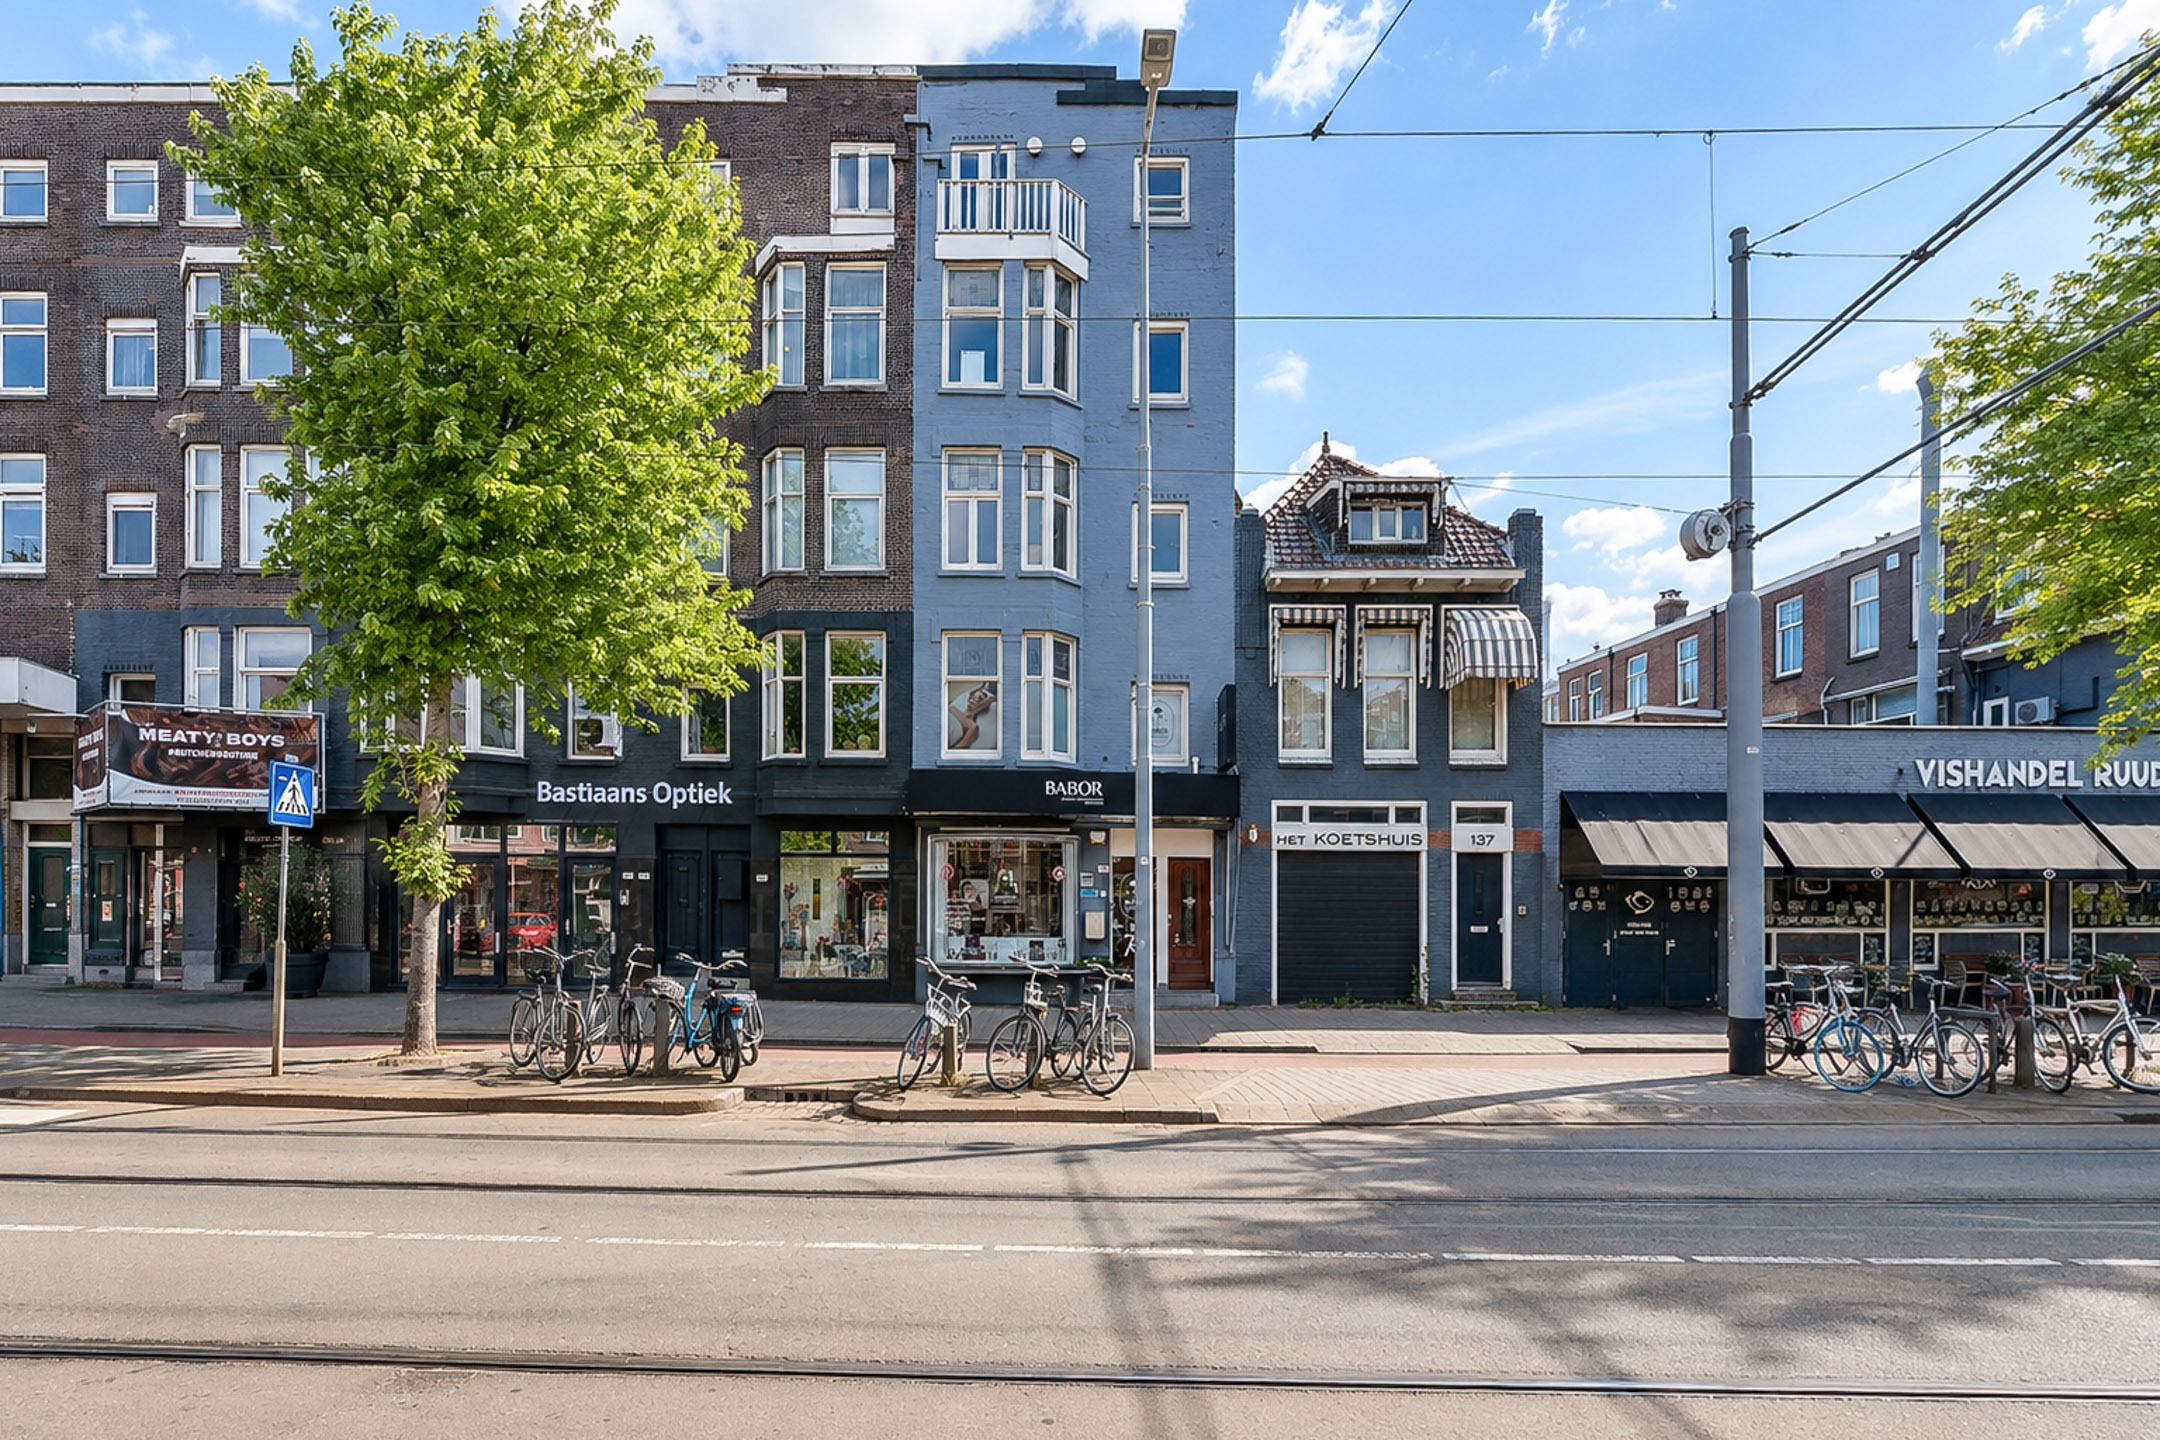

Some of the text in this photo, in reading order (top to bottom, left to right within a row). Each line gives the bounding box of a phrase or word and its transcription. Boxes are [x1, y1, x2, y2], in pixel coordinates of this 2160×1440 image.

[139, 727, 285, 748] MEATY BOYS
[1915, 759, 2083, 788] VISHANDEL
[537, 781, 733, 809] Bastiaans Optiek
[1045, 780, 1103, 797] BABOR
[1276, 832, 1423, 846] HET KOETSHUIS
[1470, 834, 1495, 846] 137
